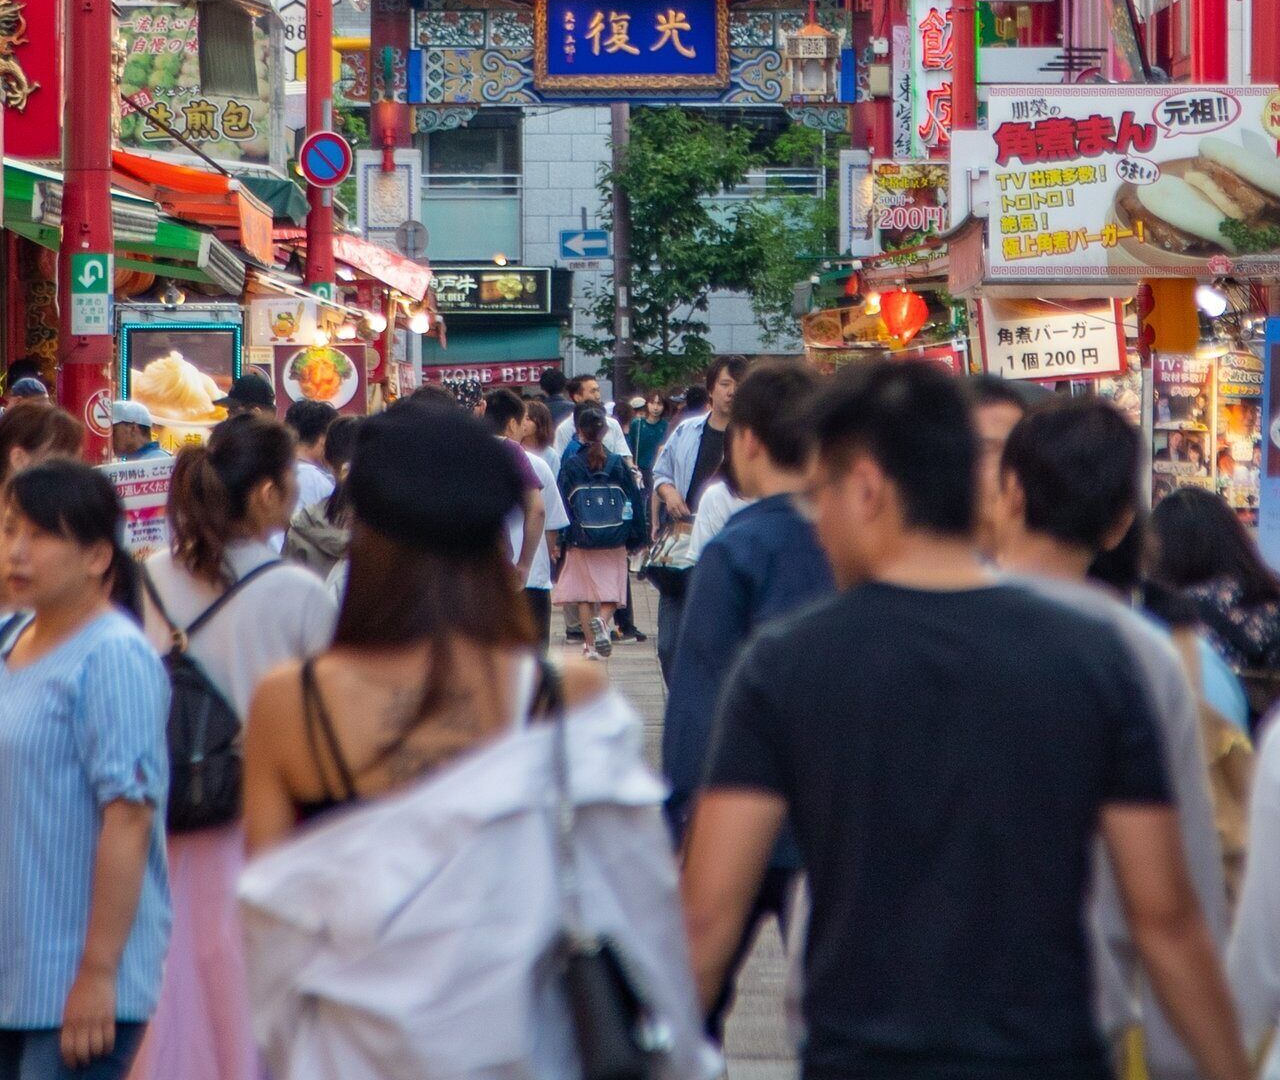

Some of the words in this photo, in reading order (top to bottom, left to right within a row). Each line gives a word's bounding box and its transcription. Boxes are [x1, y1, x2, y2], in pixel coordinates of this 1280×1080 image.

[142, 99, 257, 142] 生煎包
[992, 110, 1158, 167] 角煮まん
[879, 206, 946, 233] 200円
[997, 321, 1106, 347] 角煮バーガー
